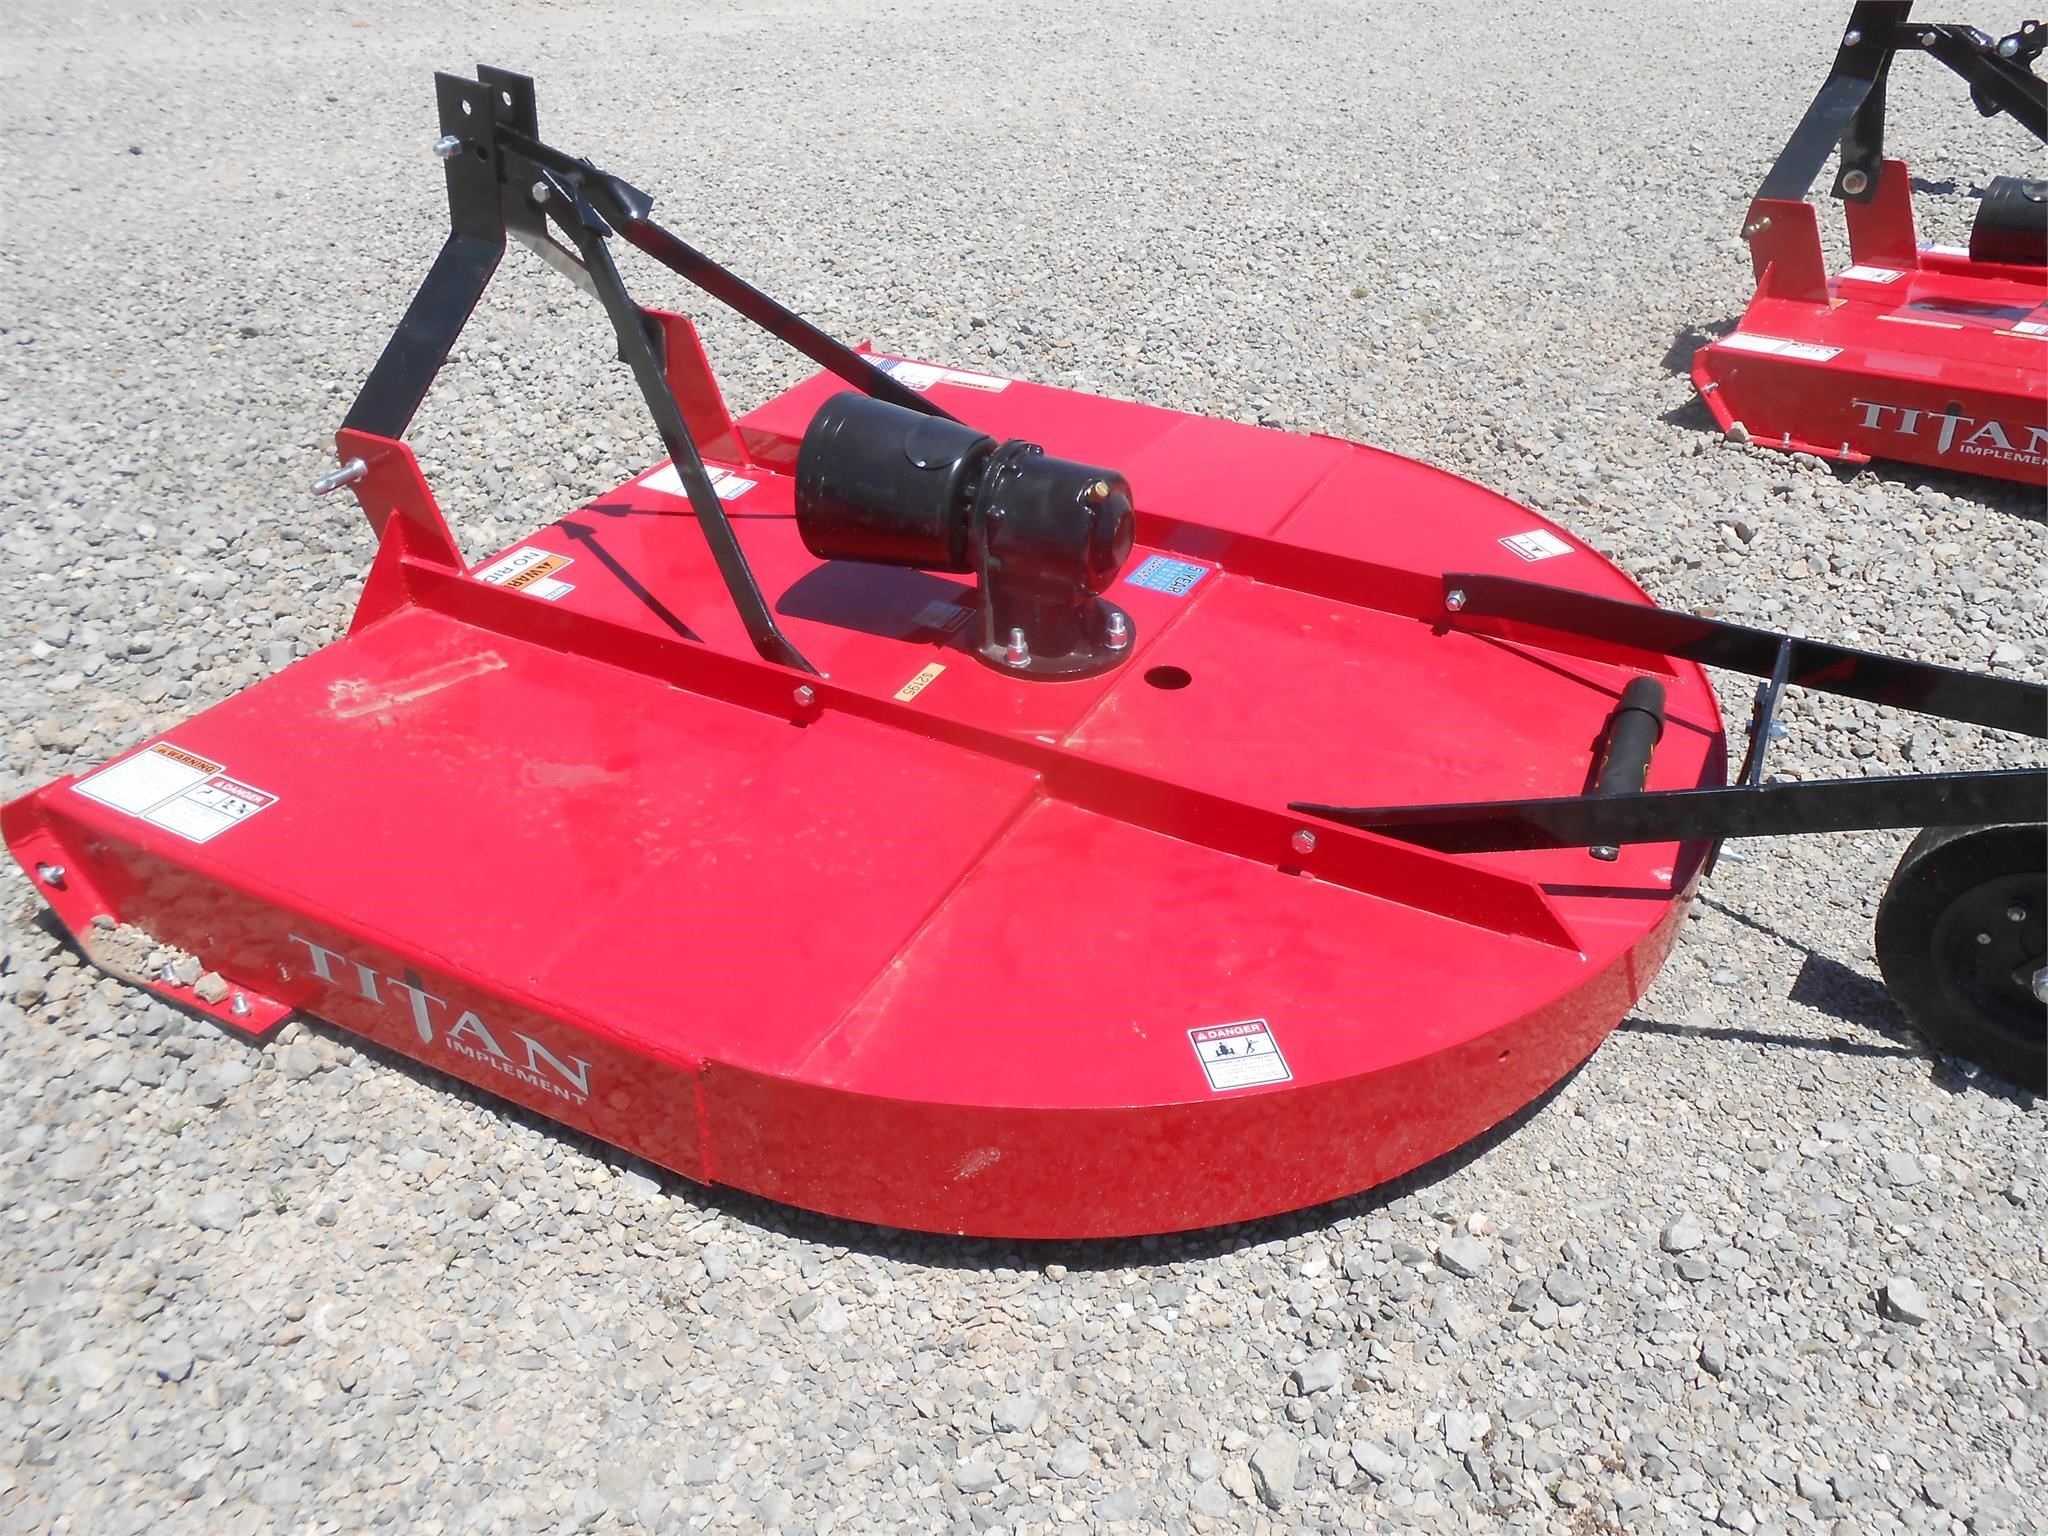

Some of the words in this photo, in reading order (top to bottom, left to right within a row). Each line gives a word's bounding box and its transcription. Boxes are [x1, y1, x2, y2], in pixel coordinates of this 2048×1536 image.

[513, 552, 540, 566] NO
[1166, 573, 1197, 594] YEAR
[902, 672, 934, 695] $2195
[167, 749, 216, 774] WARNING
[222, 782, 266, 804] DANGER
[288, 934, 592, 1095] TITAN
[1206, 1023, 1262, 1039] DANGER
[445, 1036, 588, 1106] IMPLEMENT
